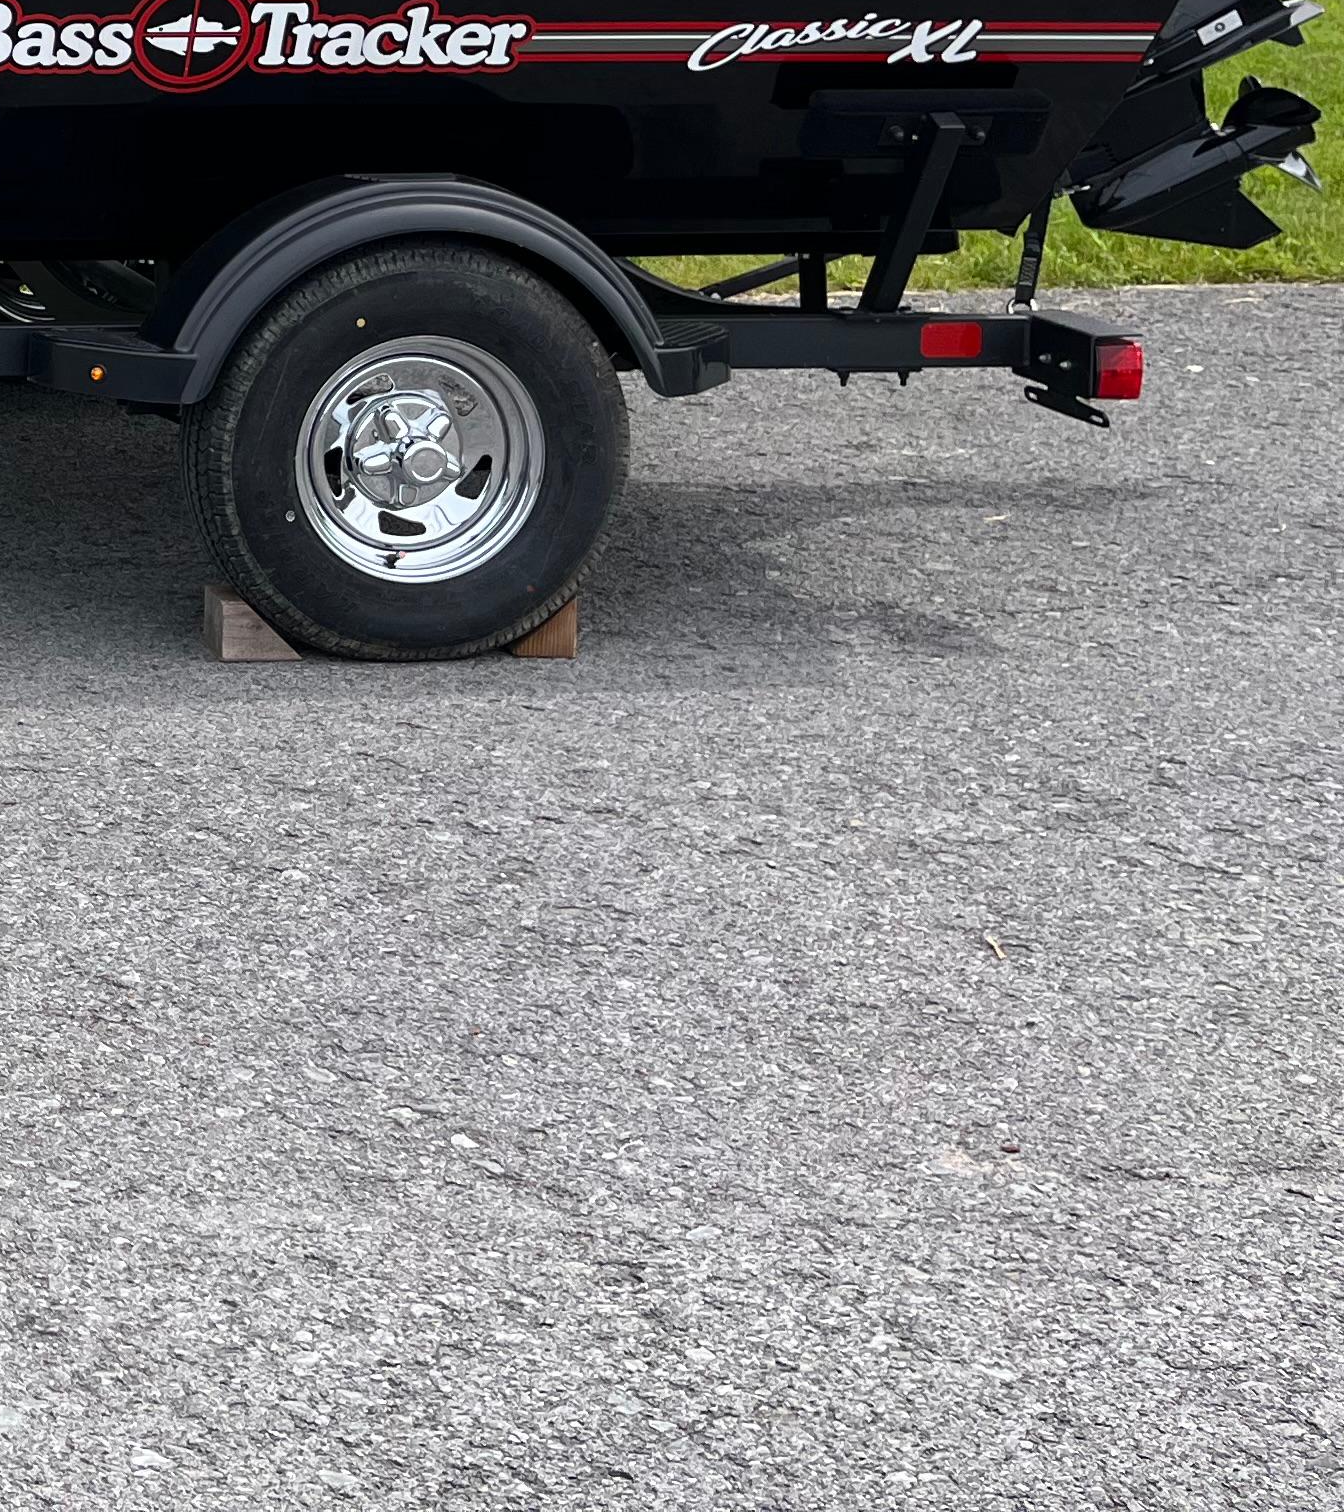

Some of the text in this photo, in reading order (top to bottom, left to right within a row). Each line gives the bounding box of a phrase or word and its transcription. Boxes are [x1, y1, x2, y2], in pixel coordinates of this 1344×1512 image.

[247, 1, 528, 67] Tracker
[686, 12, 983, 72] Classic XL
